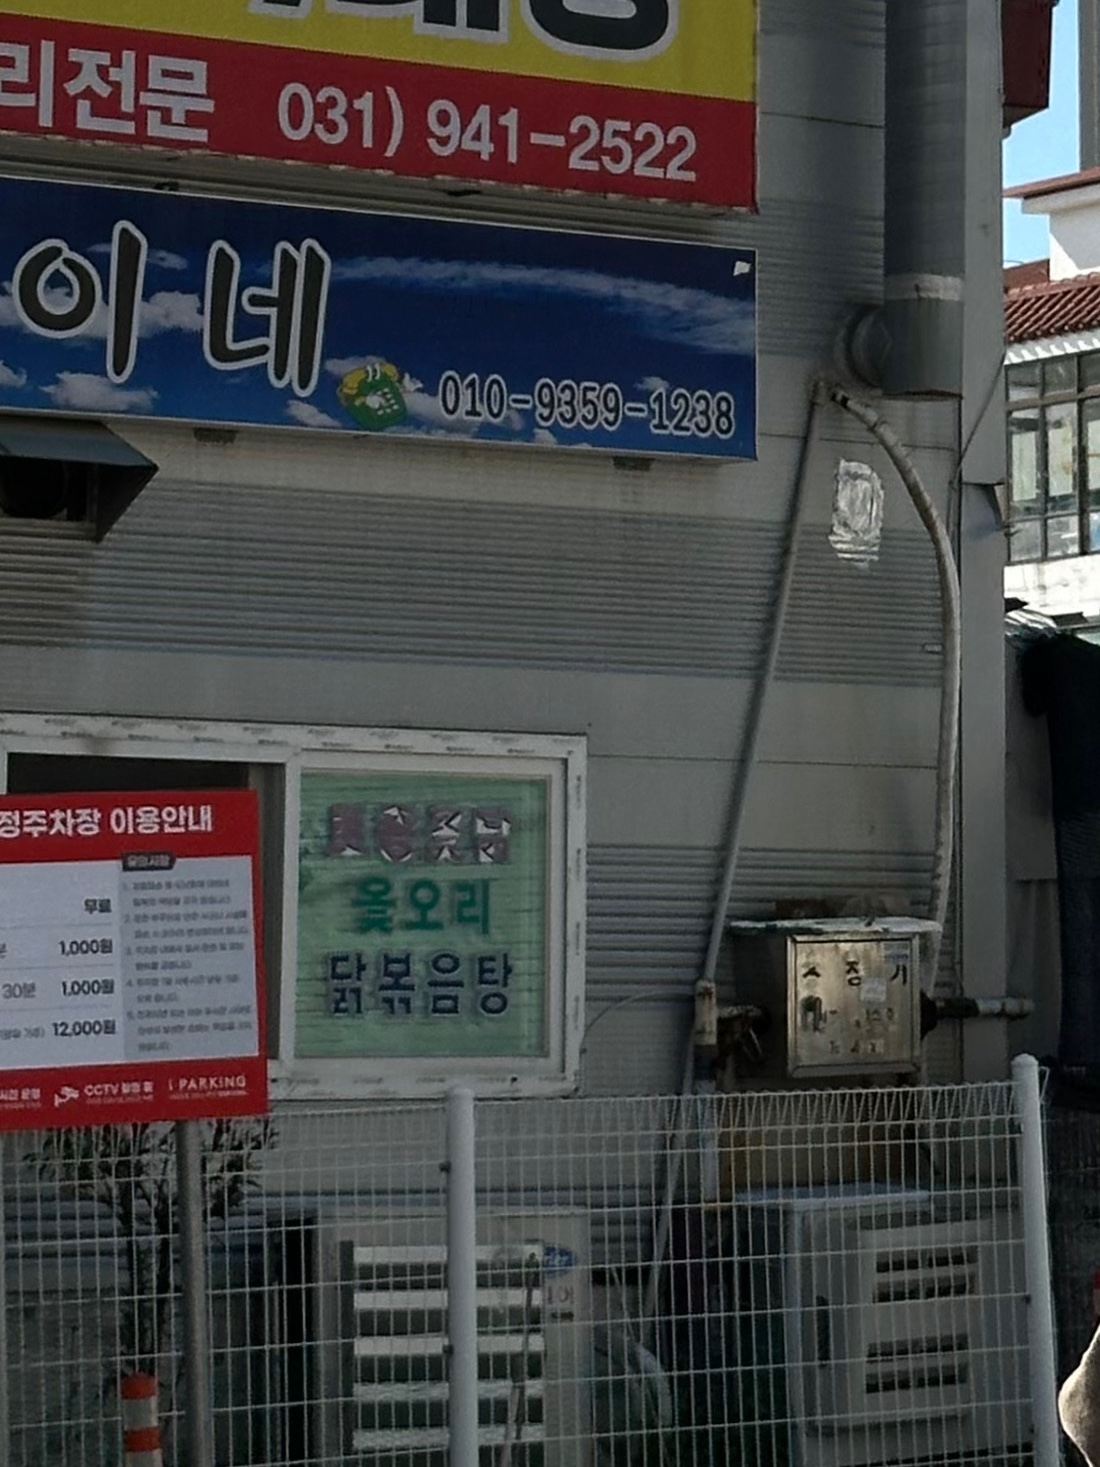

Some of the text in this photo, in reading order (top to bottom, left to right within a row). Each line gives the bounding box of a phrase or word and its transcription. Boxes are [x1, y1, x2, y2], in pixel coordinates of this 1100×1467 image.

[0, 39, 697, 183] 리전문 031) 941-2522
[438, 370, 735, 438] 010-9359-1238
[110, 804, 213, 834] 이용안내
[59, 938, 113, 957] 1,000원
[61, 979, 114, 996] 1,000원
[330, 951, 513, 1016] 닭볶음탕
[52, 1019, 116, 1037] 12,000원
[84, 1083, 119, 1096] CCTV
